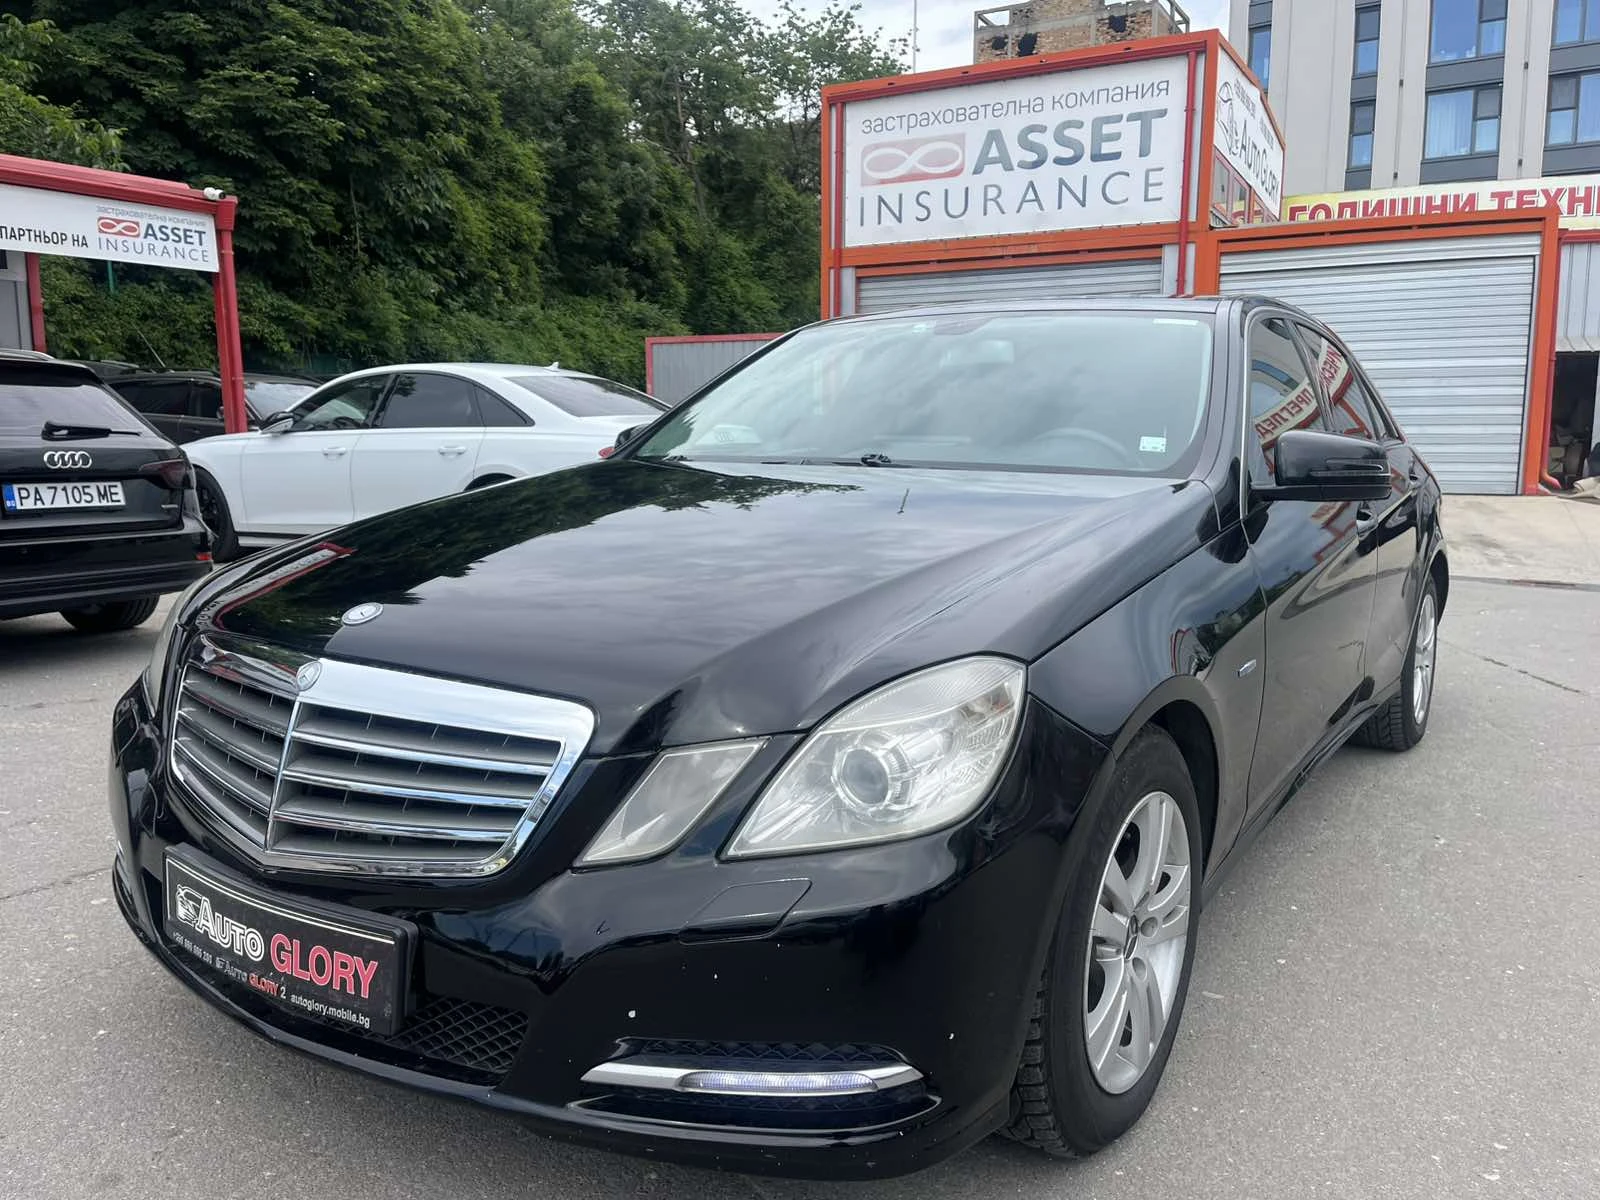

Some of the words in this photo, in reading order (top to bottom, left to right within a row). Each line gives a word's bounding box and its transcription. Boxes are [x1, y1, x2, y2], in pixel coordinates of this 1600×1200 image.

[861, 96, 1045, 134] застрахователна
[1052, 79, 1170, 111] компания
[971, 108, 1168, 176] ASSET
[859, 166, 1165, 227] INSURANCE
[1490, 185, 1600, 216] ТЕХН
[0, 225, 67, 245] ПАРТНЬОР
[72, 233, 88, 248] НА
[98, 237, 209, 263] INSURANCE
[143, 223, 206, 246] ASSET
[196, 896, 265, 961] AUTO
[270, 933, 379, 999] GLORY
[290, 993, 370, 1029] autoglory.mobile.bg
